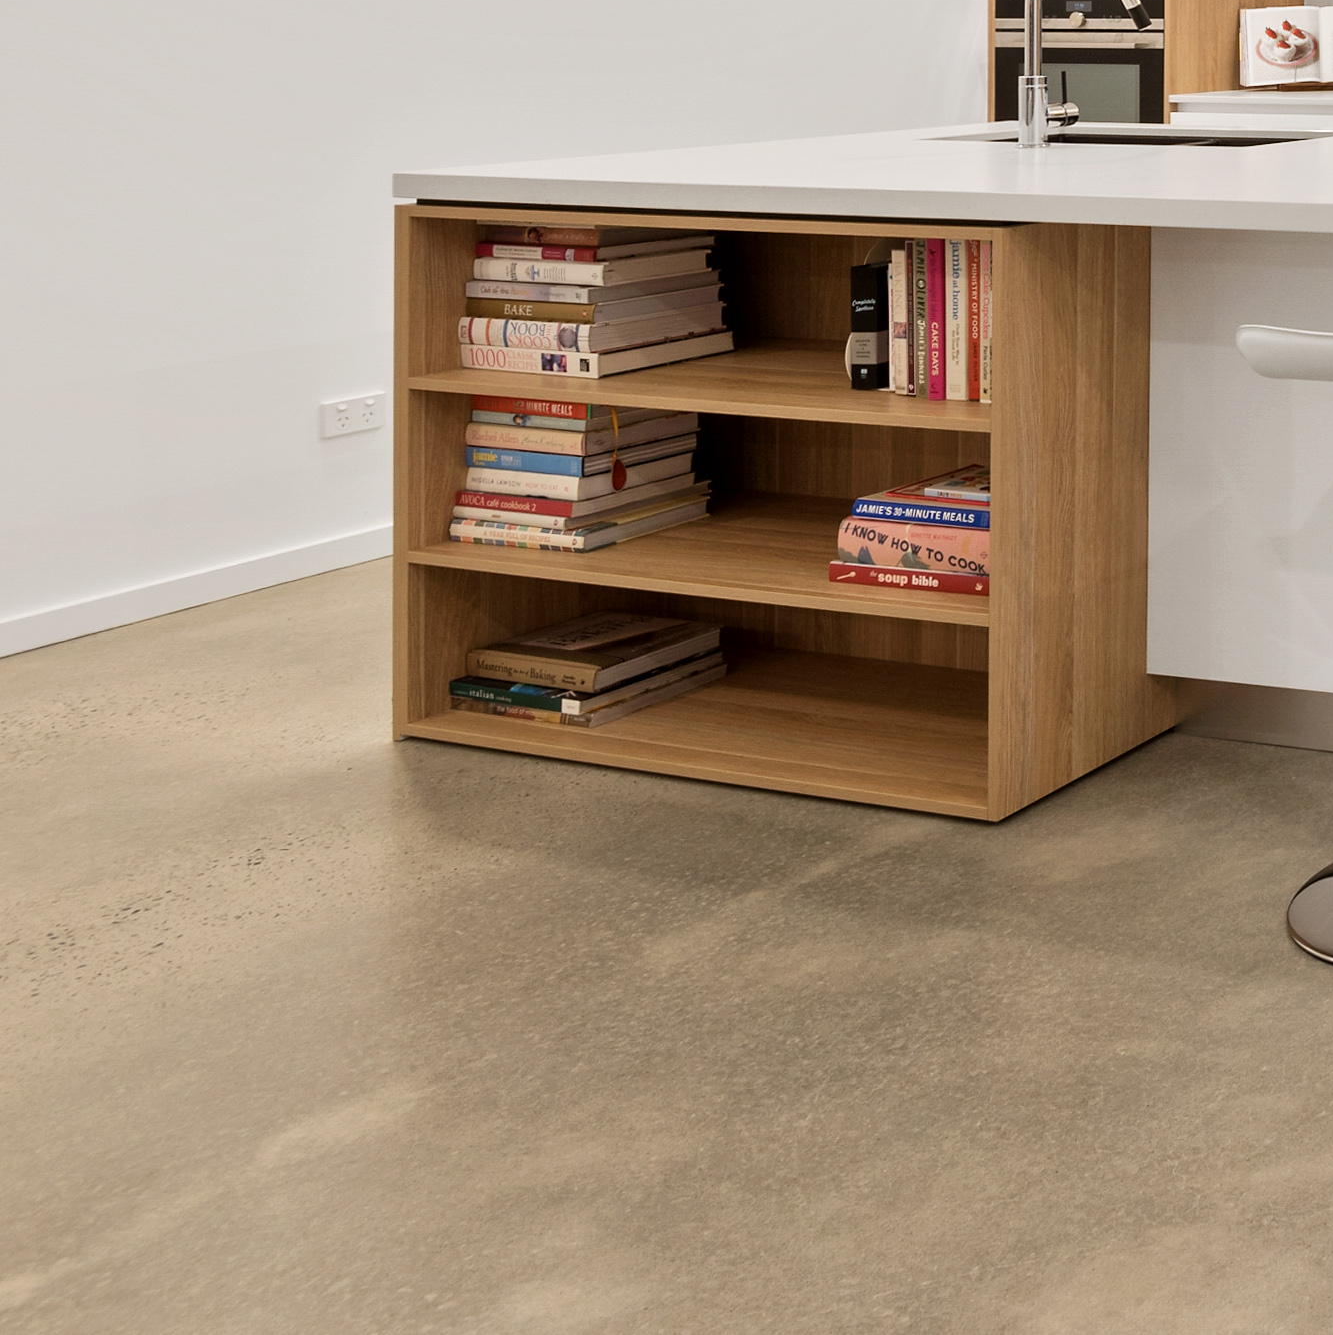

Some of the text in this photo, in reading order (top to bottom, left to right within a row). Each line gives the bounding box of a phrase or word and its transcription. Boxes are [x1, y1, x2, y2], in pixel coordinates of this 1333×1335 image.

[949, 239, 962, 279] jamie
[916, 240, 927, 319] JAMIE OLIVER
[971, 263, 979, 301] MINISTRY
[982, 273, 991, 295] Cake
[503, 303, 534, 317] BAKE
[952, 290, 961, 320] home
[971, 302, 979, 313] OF
[510, 321, 547, 337] BOOK
[971, 315, 979, 339] FOOD
[982, 297, 991, 340] Cupcakes
[507, 334, 552, 350] COOK'S
[931, 322, 939, 349] CAKE
[469, 347, 507, 368] 1000
[506, 349, 538, 361] CLASSIC
[507, 360, 539, 371] RECIPES
[931, 351, 939, 376] DAYS
[551, 404, 574, 417] MEALS
[471, 430, 498, 442] Rachel
[499, 432, 519, 444] Allen
[496, 479, 521, 488] LAWSON
[525, 482, 539, 490] HOW
[459, 493, 537, 512] AVOCA café cookbook 2
[856, 503, 975, 524] JAMIE'S 30-MINUTE MEALS
[844, 522, 987, 575] I KNOW HOW TO COOK
[877, 572, 909, 587] soup
[911, 574, 940, 589] bible
[476, 659, 513, 677] Mastering
[530, 667, 556, 684] Baking
[469, 688, 495, 700] italian
